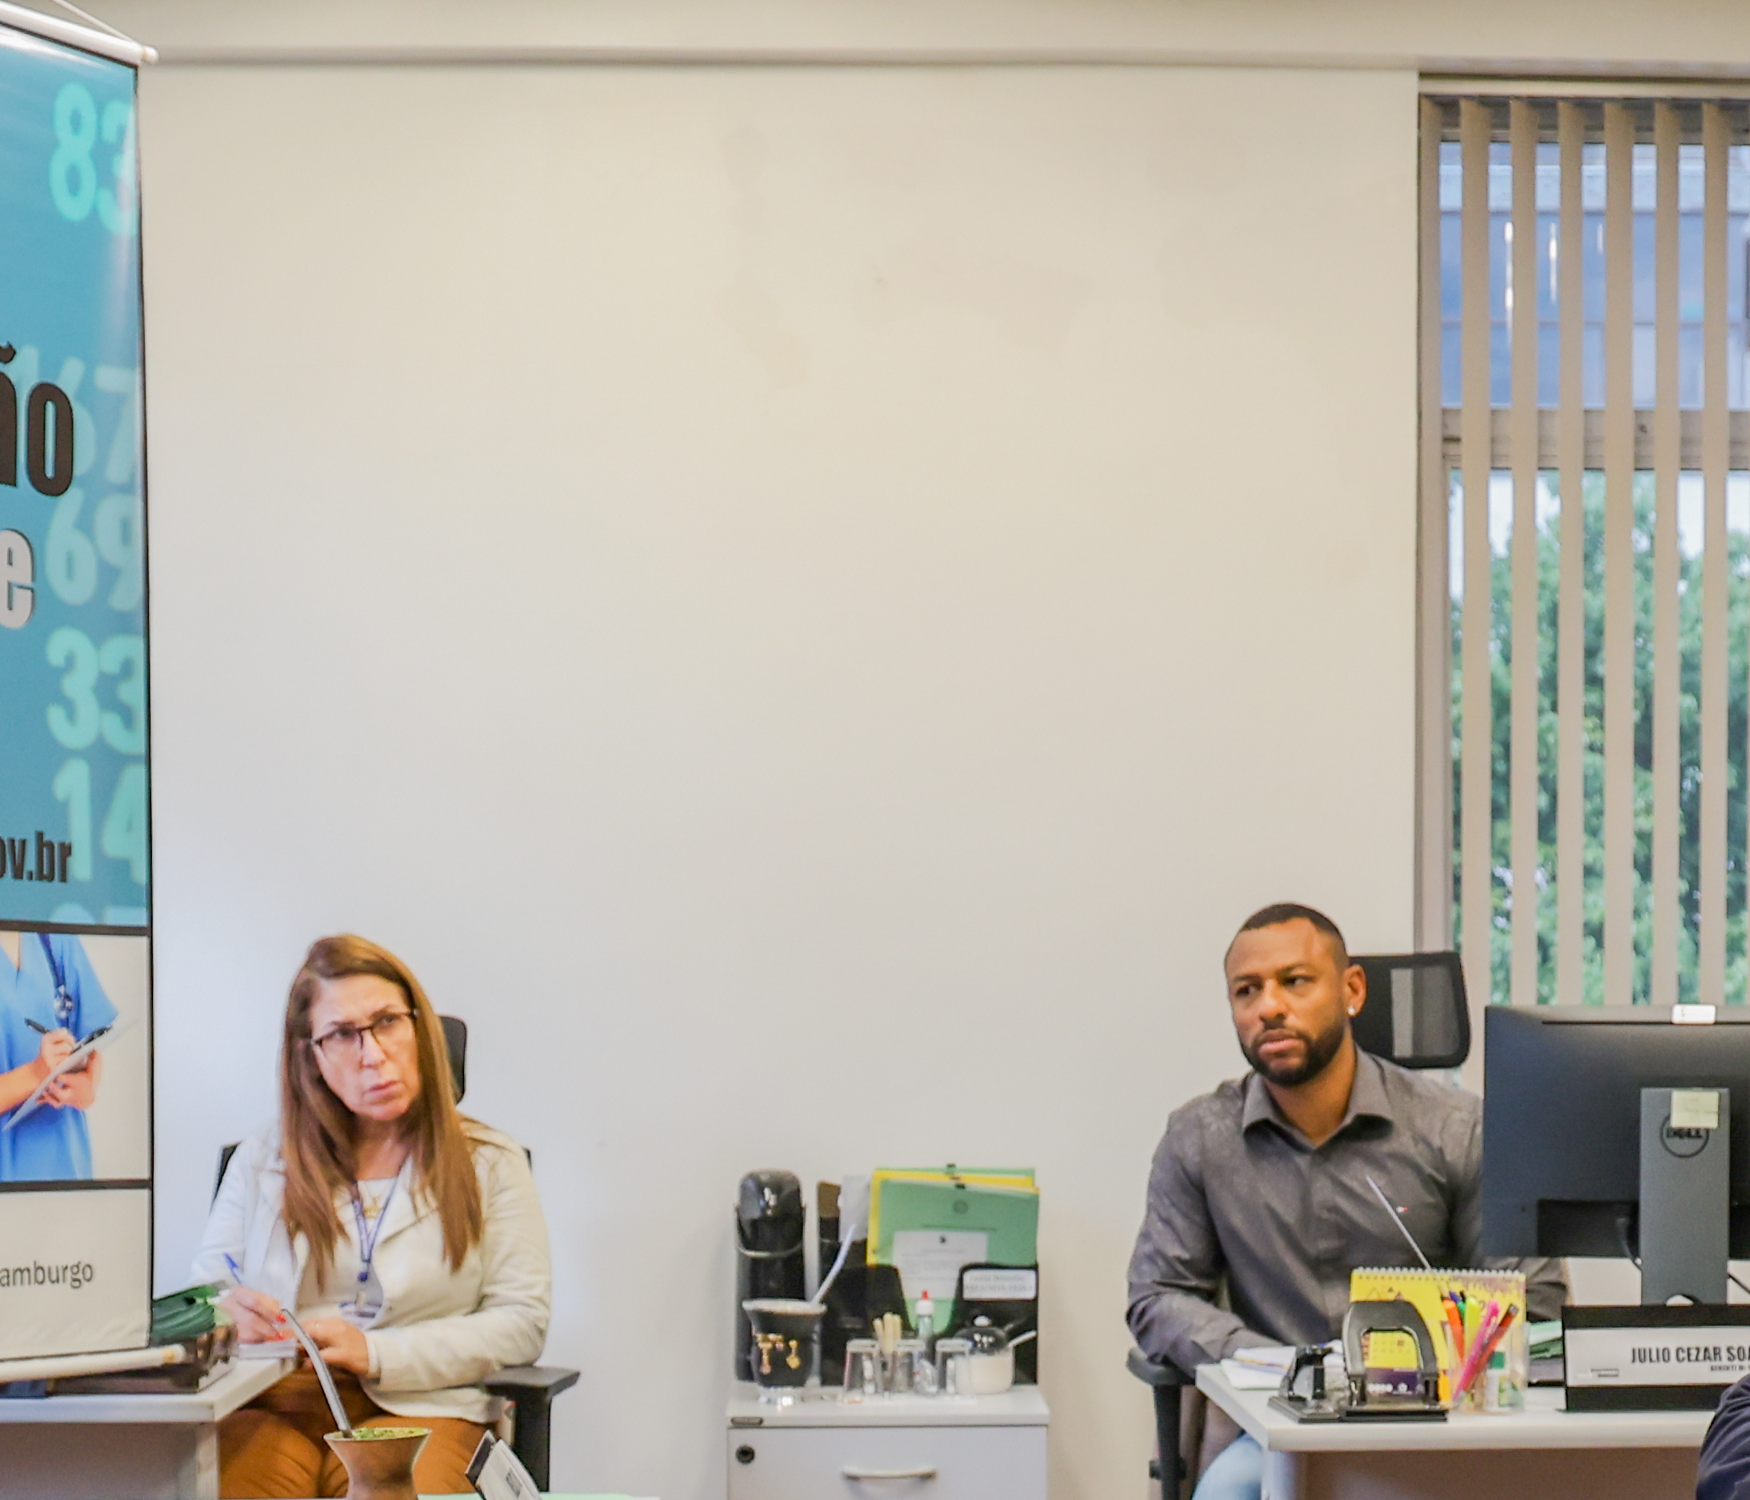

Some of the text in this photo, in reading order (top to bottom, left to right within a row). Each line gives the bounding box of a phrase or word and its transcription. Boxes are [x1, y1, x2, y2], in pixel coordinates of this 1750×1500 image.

[49, 81, 138, 237] 83
[46, 626, 145, 753] 33
[1630, 1347, 1671, 1364] JULIO
[1675, 1346, 1723, 1363] CEZAR
